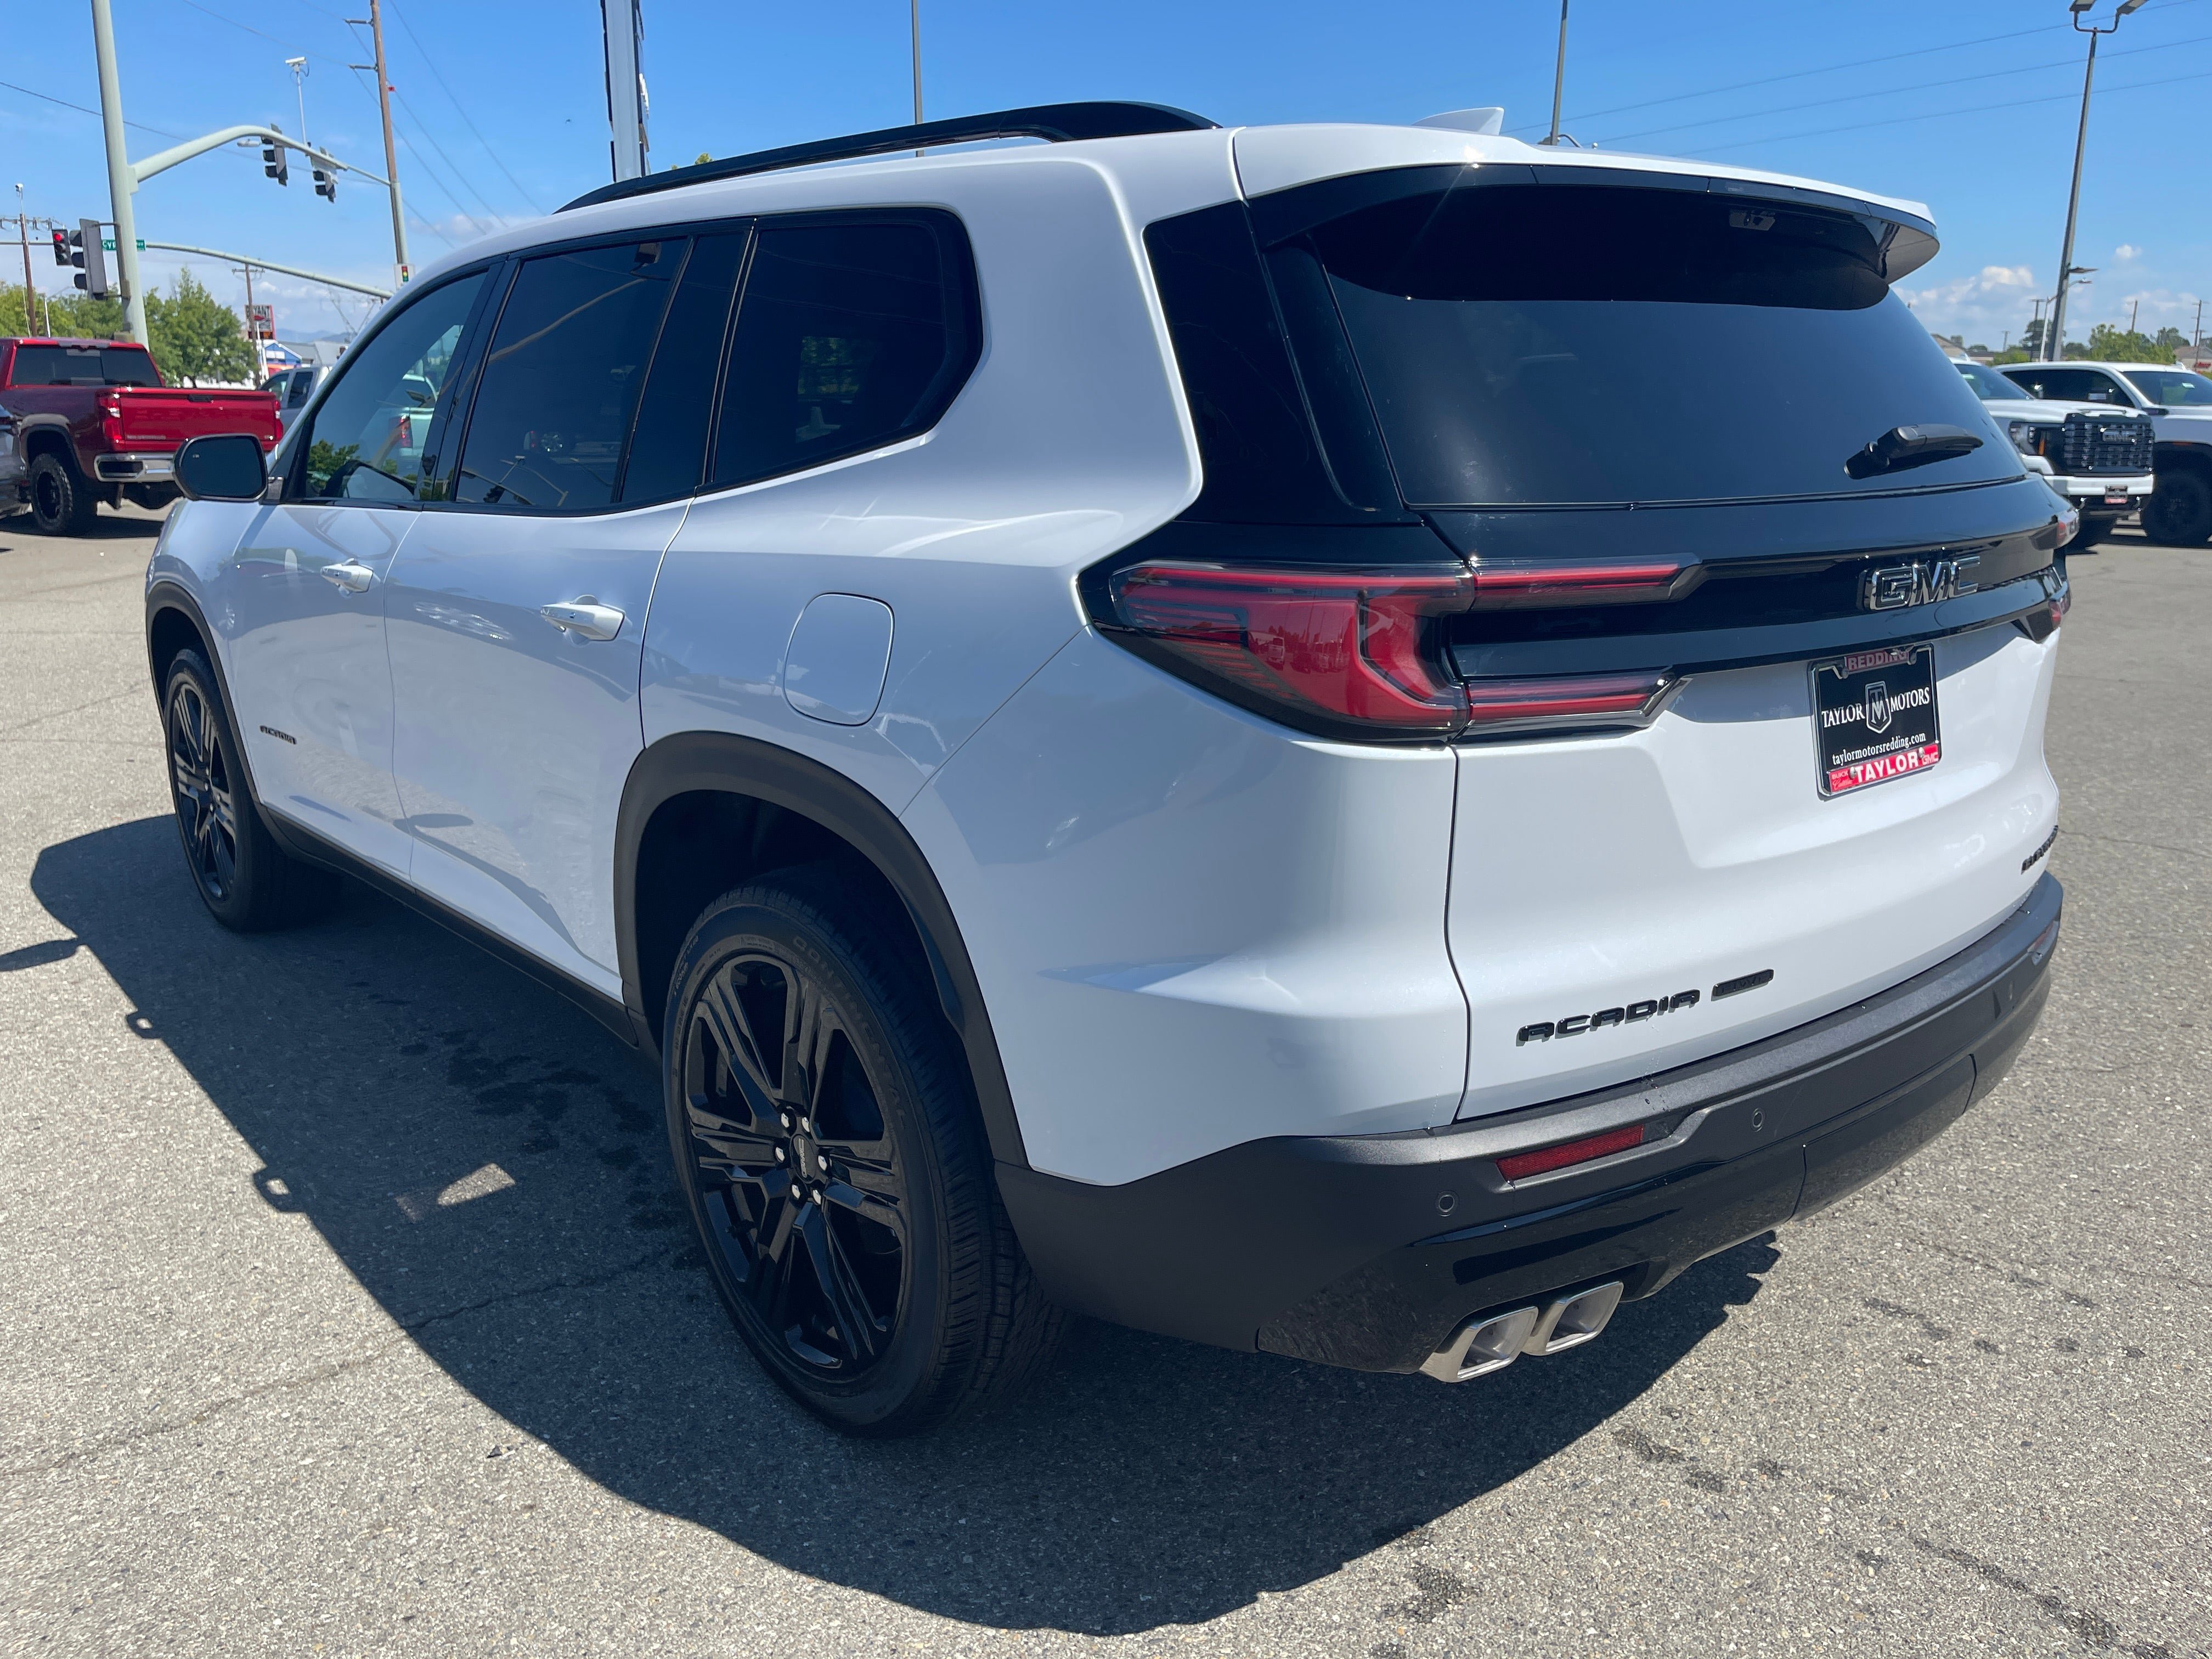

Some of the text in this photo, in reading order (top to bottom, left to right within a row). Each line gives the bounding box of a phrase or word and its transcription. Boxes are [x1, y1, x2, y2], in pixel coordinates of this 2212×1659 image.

[246, 304, 270, 319] BYANT
[1869, 555, 1980, 611] GMC
[1821, 687, 1929, 728] TAYLOR MOTORS
[1831, 751, 1939, 783] BUICK TAYLOR GMC
[1832, 732, 1926, 766] taylormotorsredding.com
[1518, 988, 1701, 1042] ACADIA
[798, 1137, 808, 1178] GMC
